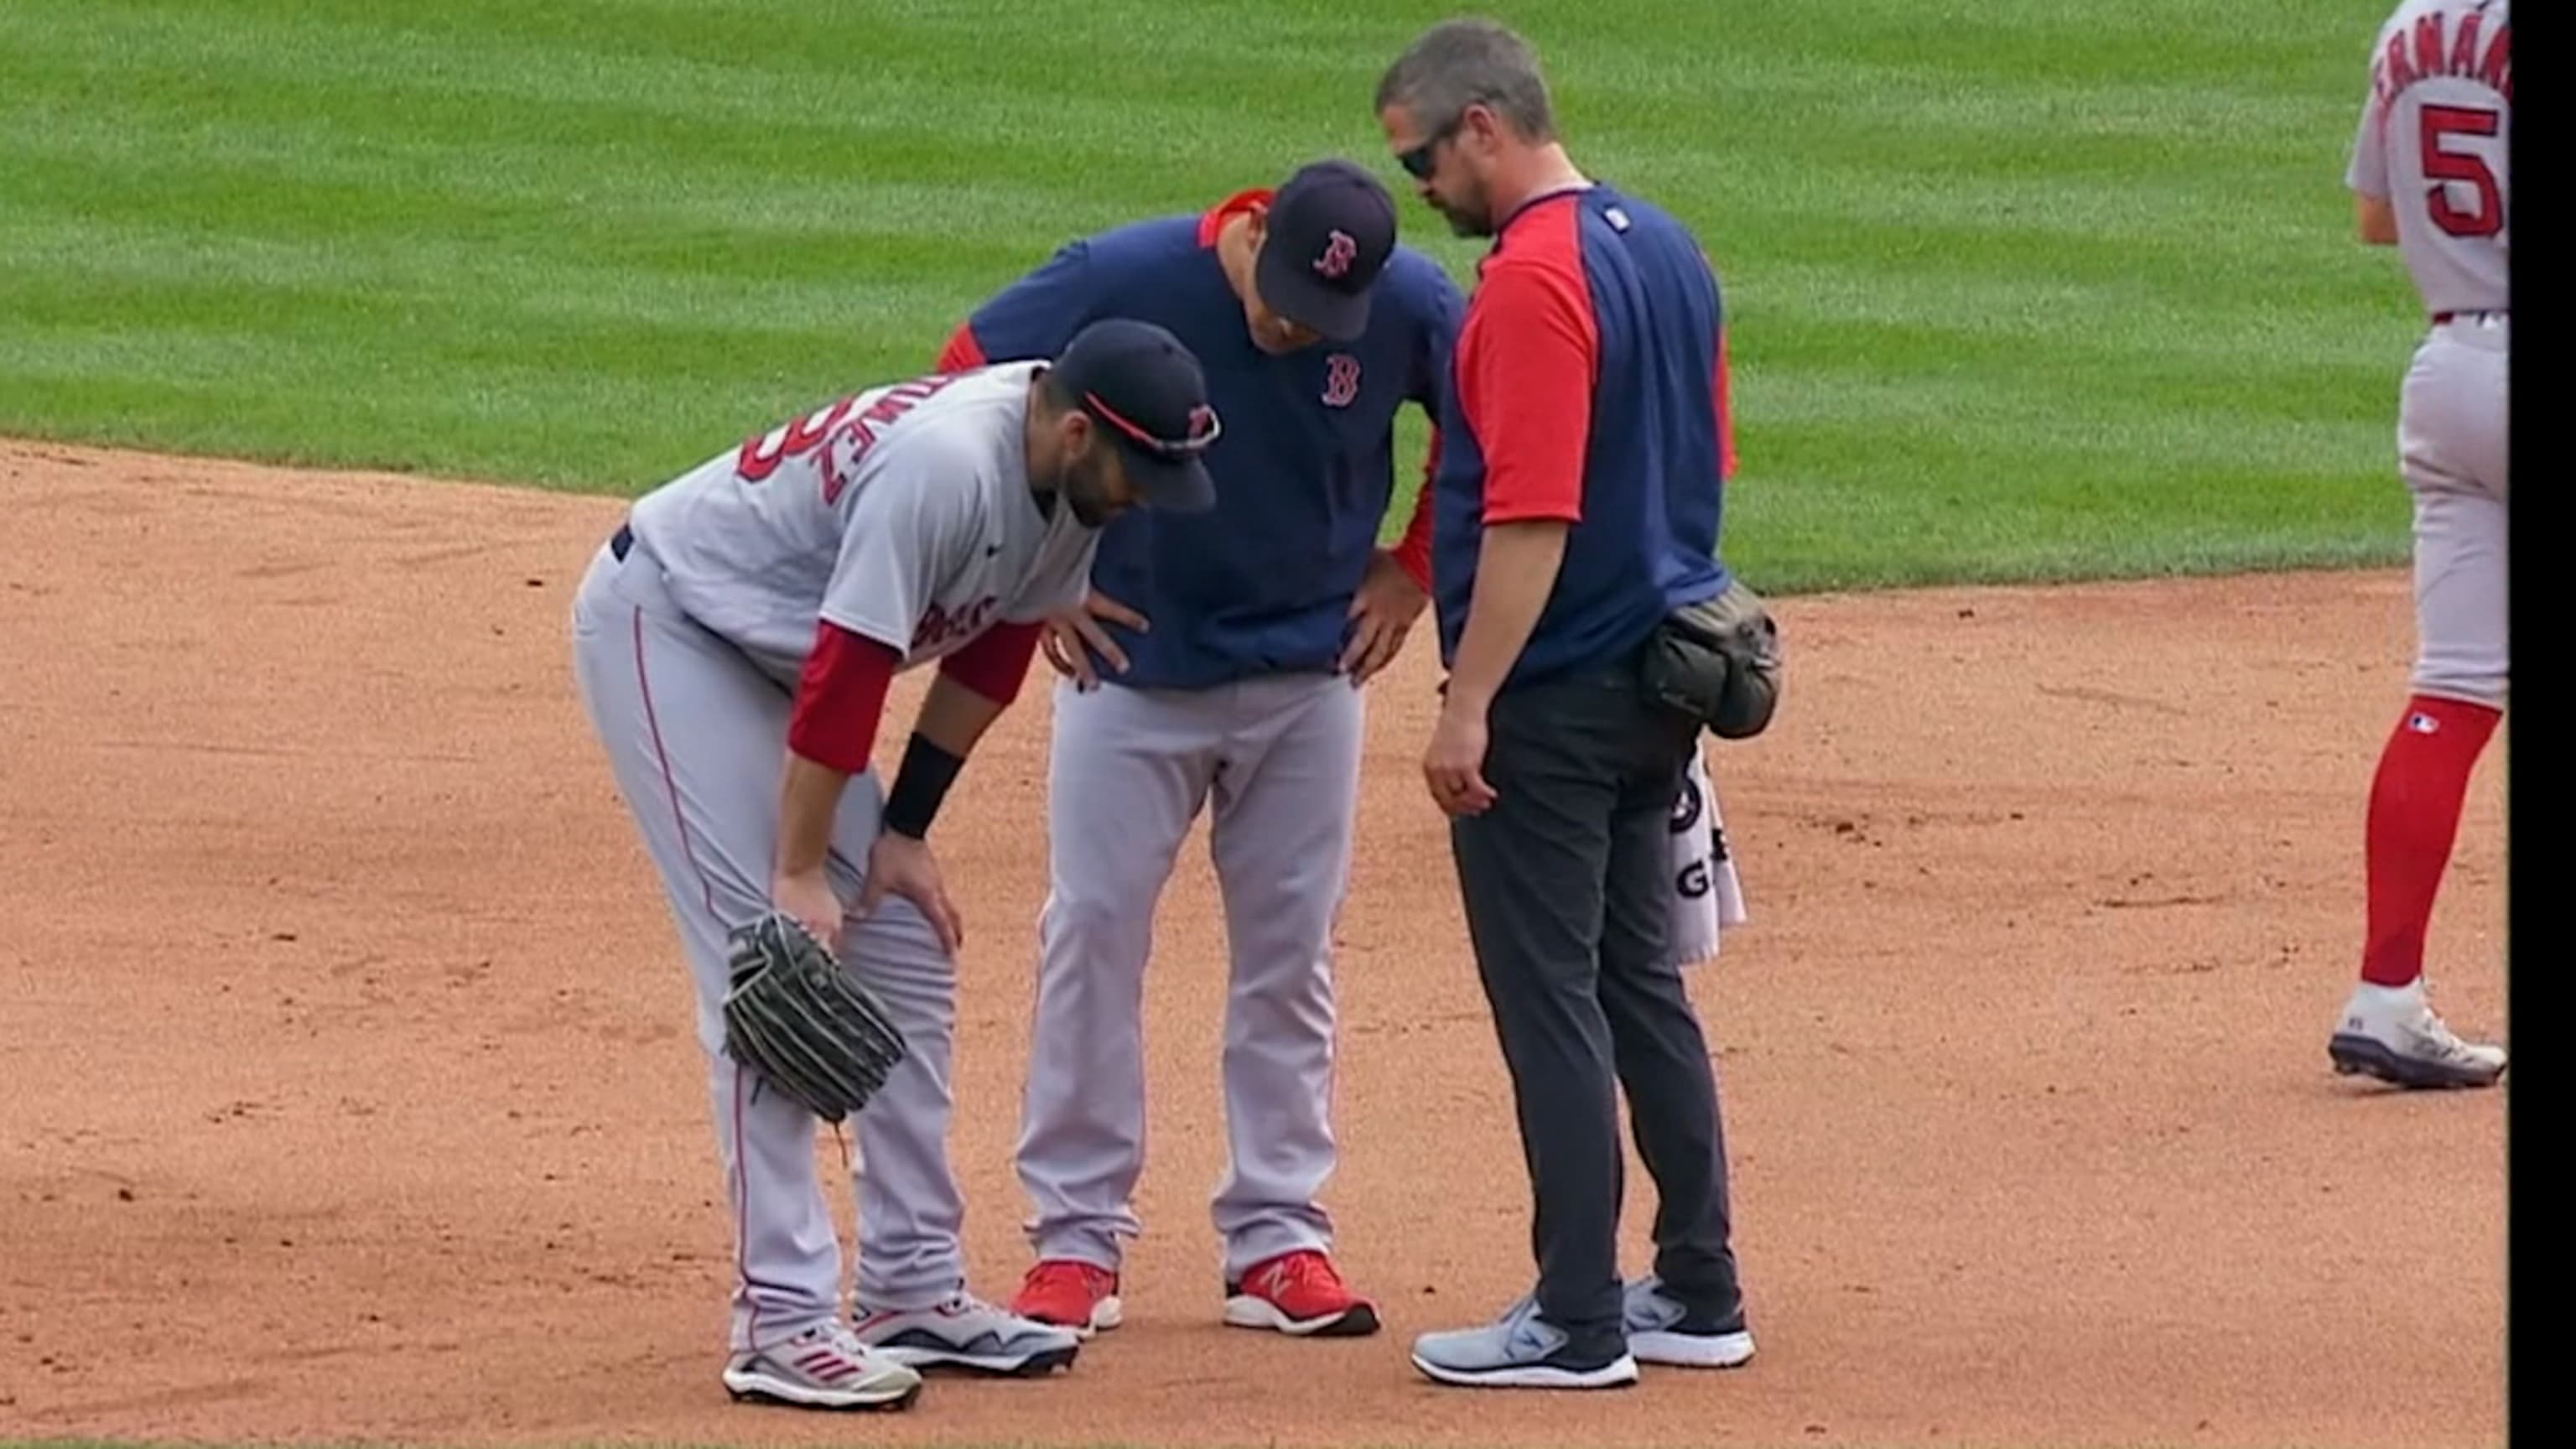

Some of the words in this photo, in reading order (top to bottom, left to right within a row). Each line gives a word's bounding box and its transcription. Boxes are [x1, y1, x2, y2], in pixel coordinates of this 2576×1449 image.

[2420, 103, 2504, 239] 5
[1313, 230, 1358, 279] B
[1321, 353, 1361, 408] B
[1676, 858, 1710, 899] G
